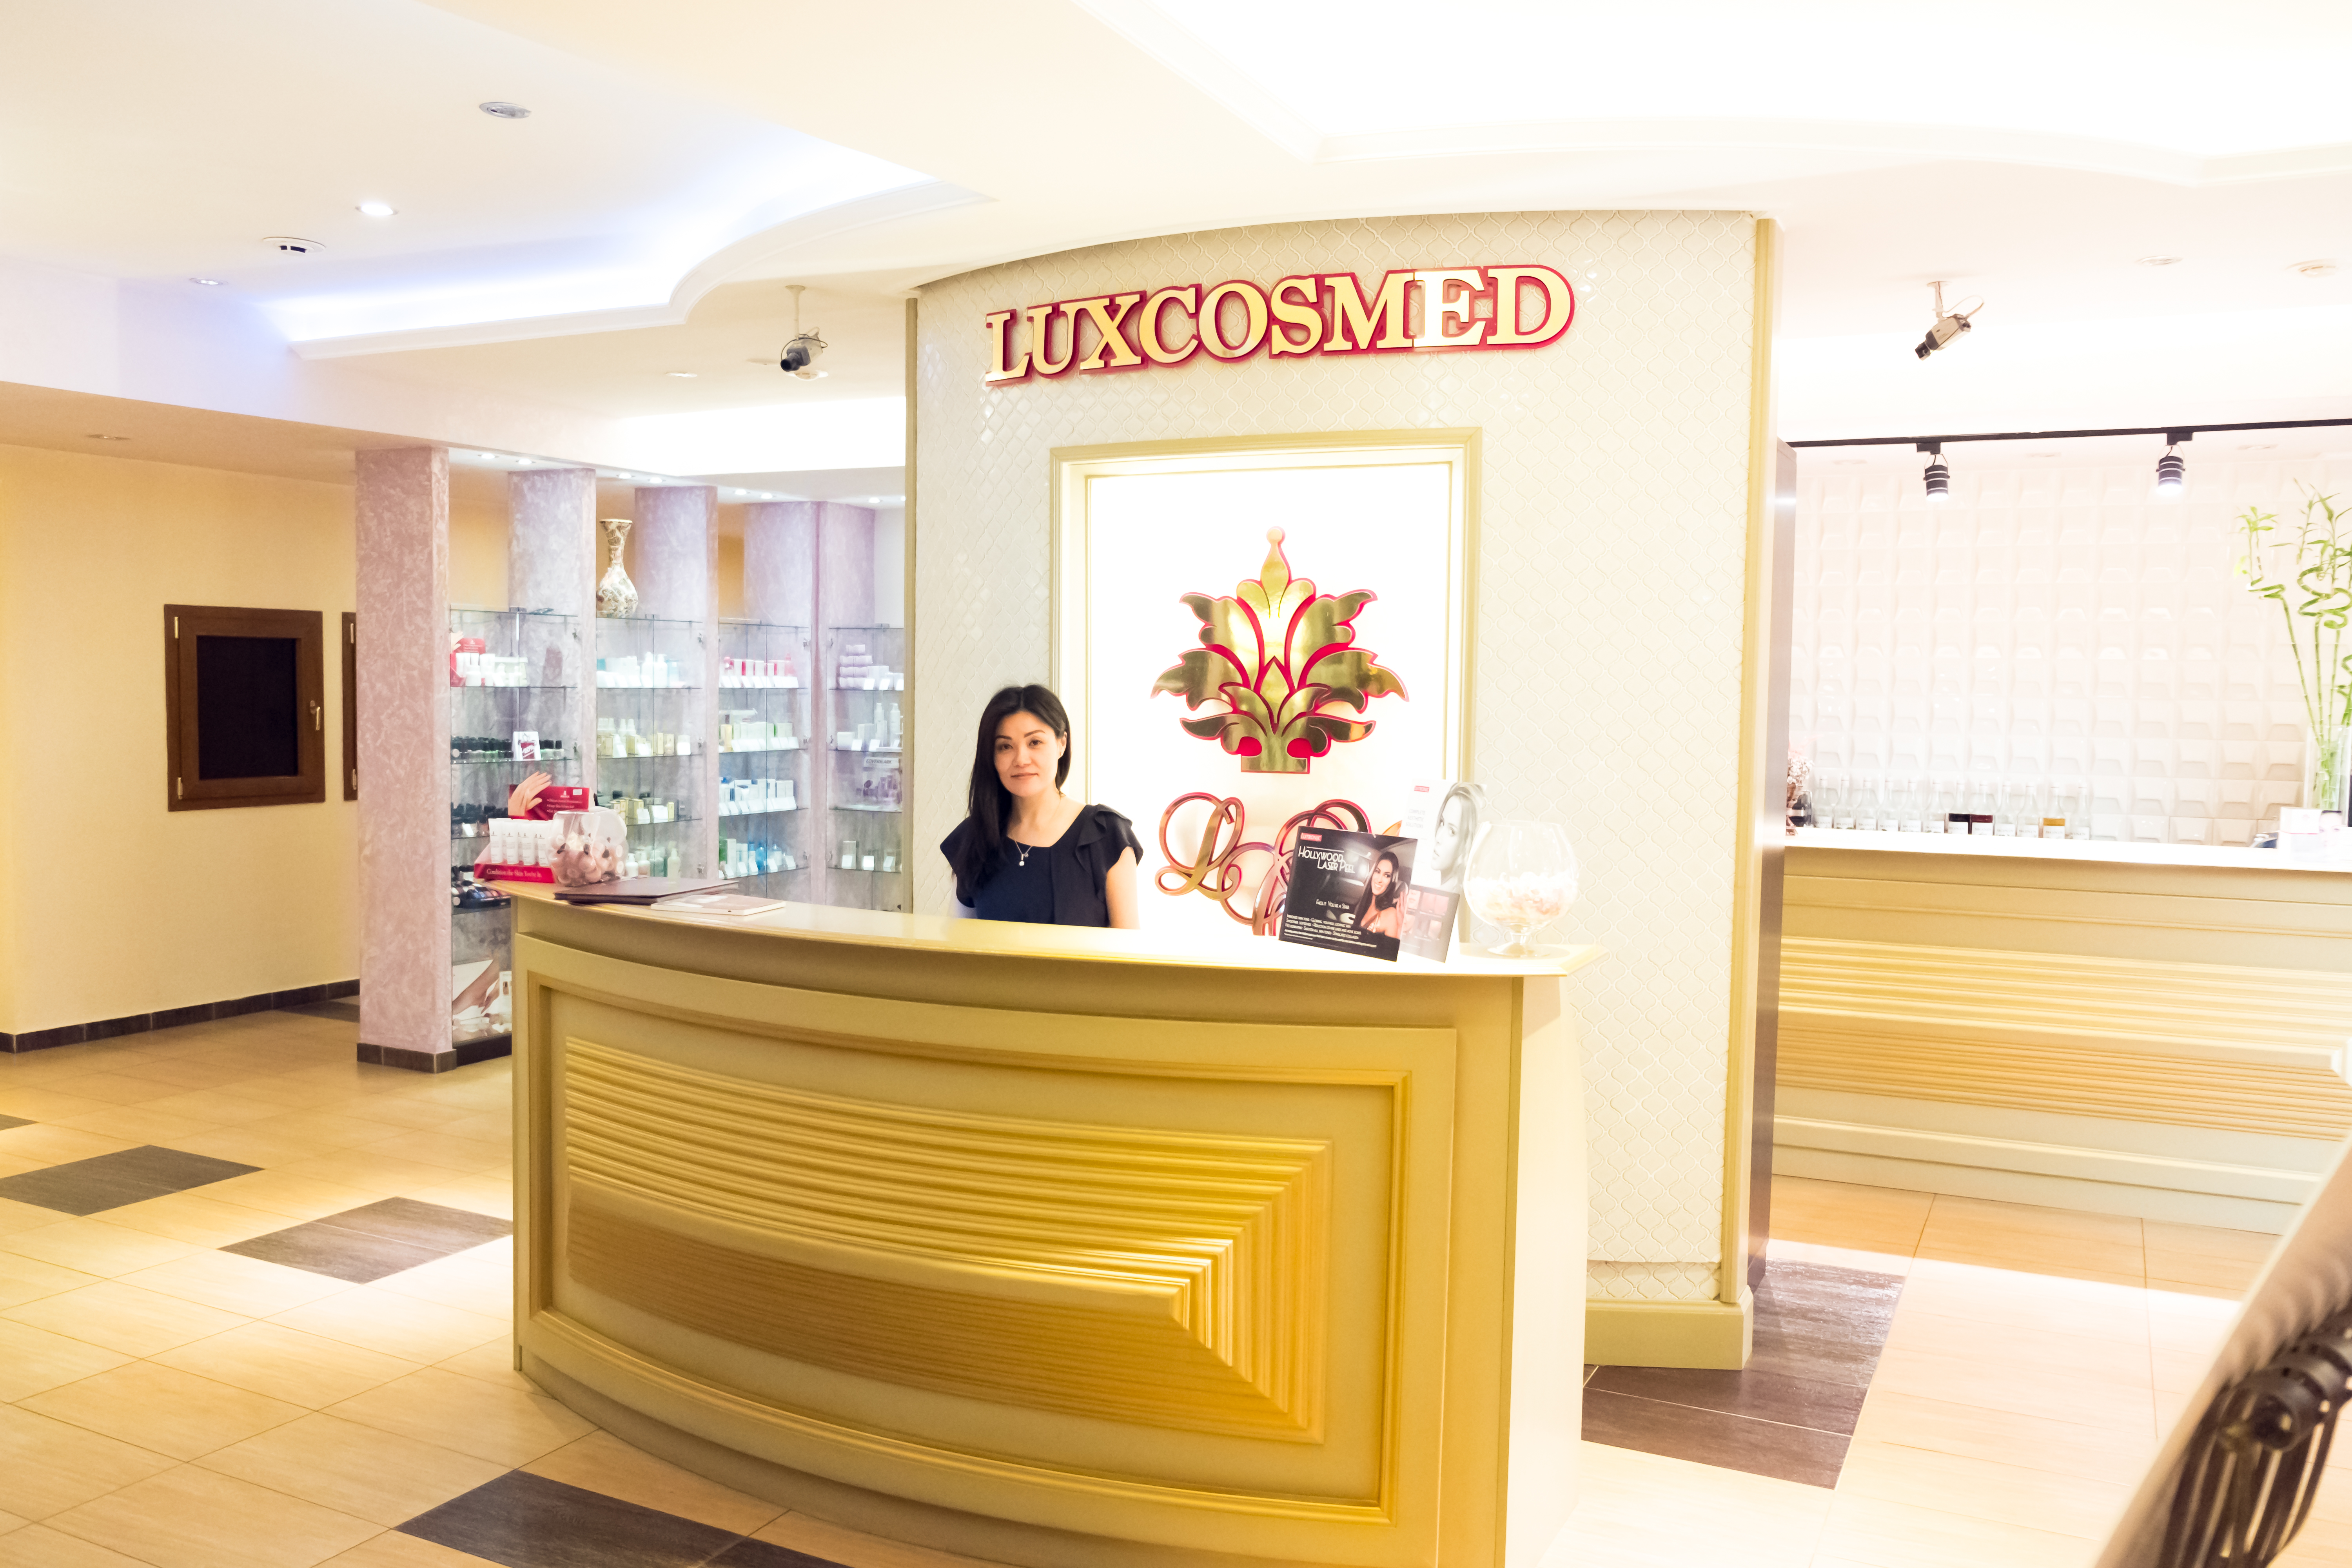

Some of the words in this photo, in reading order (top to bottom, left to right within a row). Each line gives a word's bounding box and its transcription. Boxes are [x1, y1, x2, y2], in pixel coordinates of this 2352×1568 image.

[985, 264, 1575, 387] LUXCOSMED
[1301, 833, 1321, 841] LUTRONIC
[1298, 846, 1343, 862] HOLLYWOOD
[1317, 857, 1338, 871] LASER
[1339, 860, 1356, 873] PEEL
